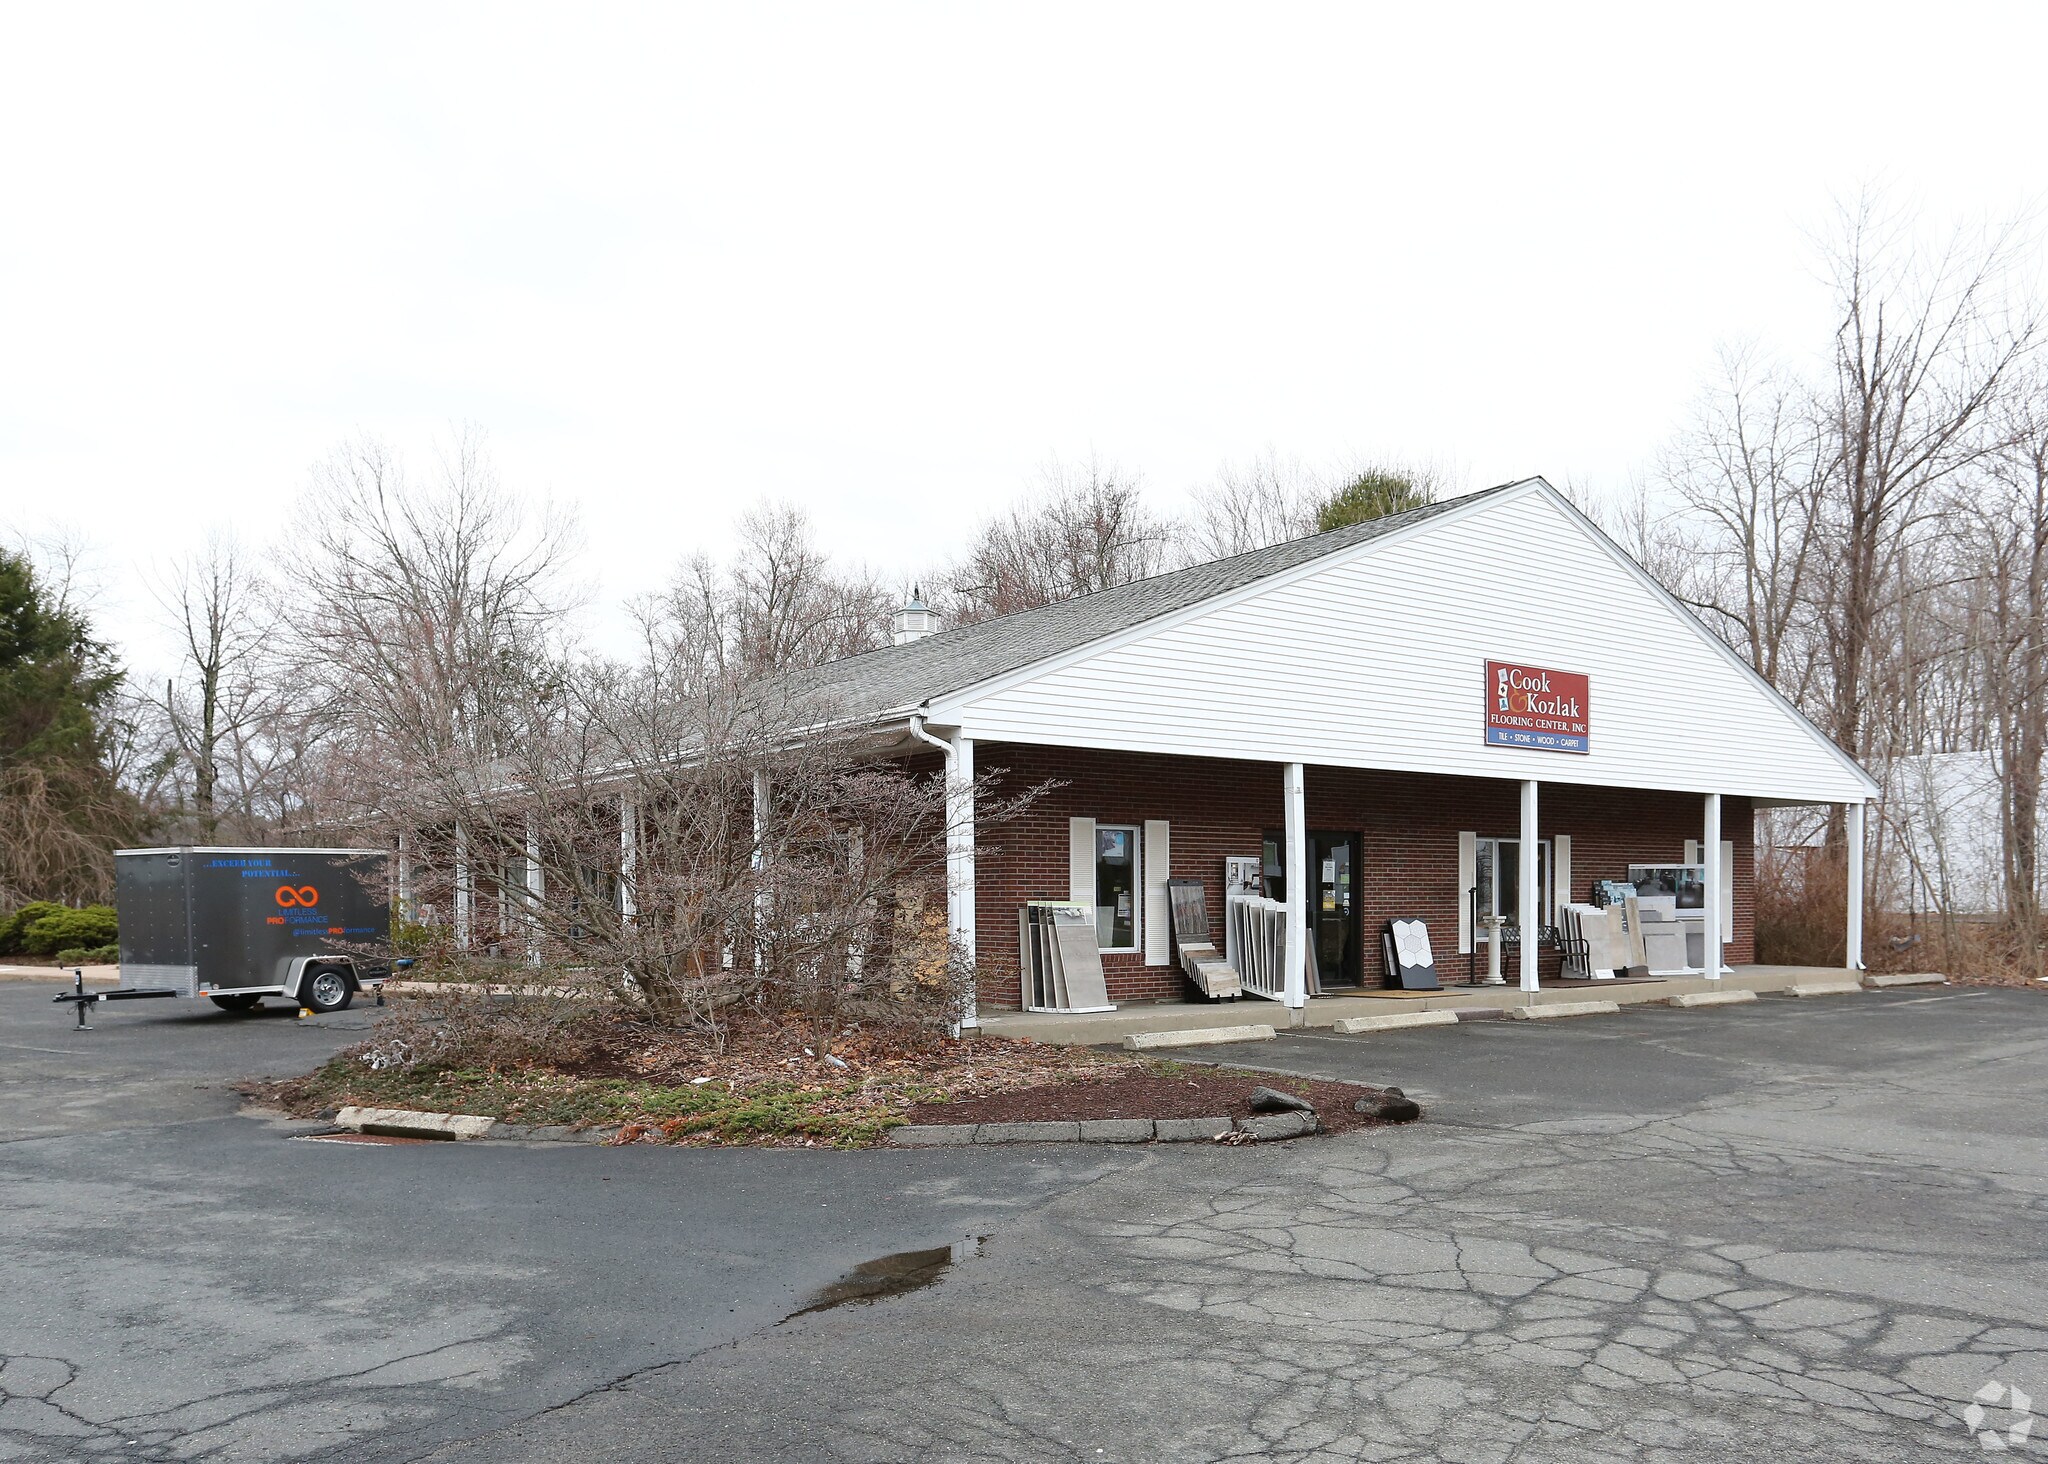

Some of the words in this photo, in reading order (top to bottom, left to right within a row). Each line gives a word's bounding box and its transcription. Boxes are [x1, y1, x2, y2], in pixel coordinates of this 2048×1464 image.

[1510, 669, 1550, 692] Cook
[1527, 692, 1579, 717] Kozlak
[1491, 714, 1533, 727] FLOORING
[1572, 723, 1587, 733] INC
[1498, 732, 1507, 740] TILE
[1515, 733, 1530, 743] STONE
[1537, 736, 1554, 745] WOOD
[1561, 739, 1579, 747] CARPET
[247, 859, 272, 867] YOUR
[266, 915, 328, 924] PROFORMANCE
[278, 908, 317, 916] LIMITLESS
